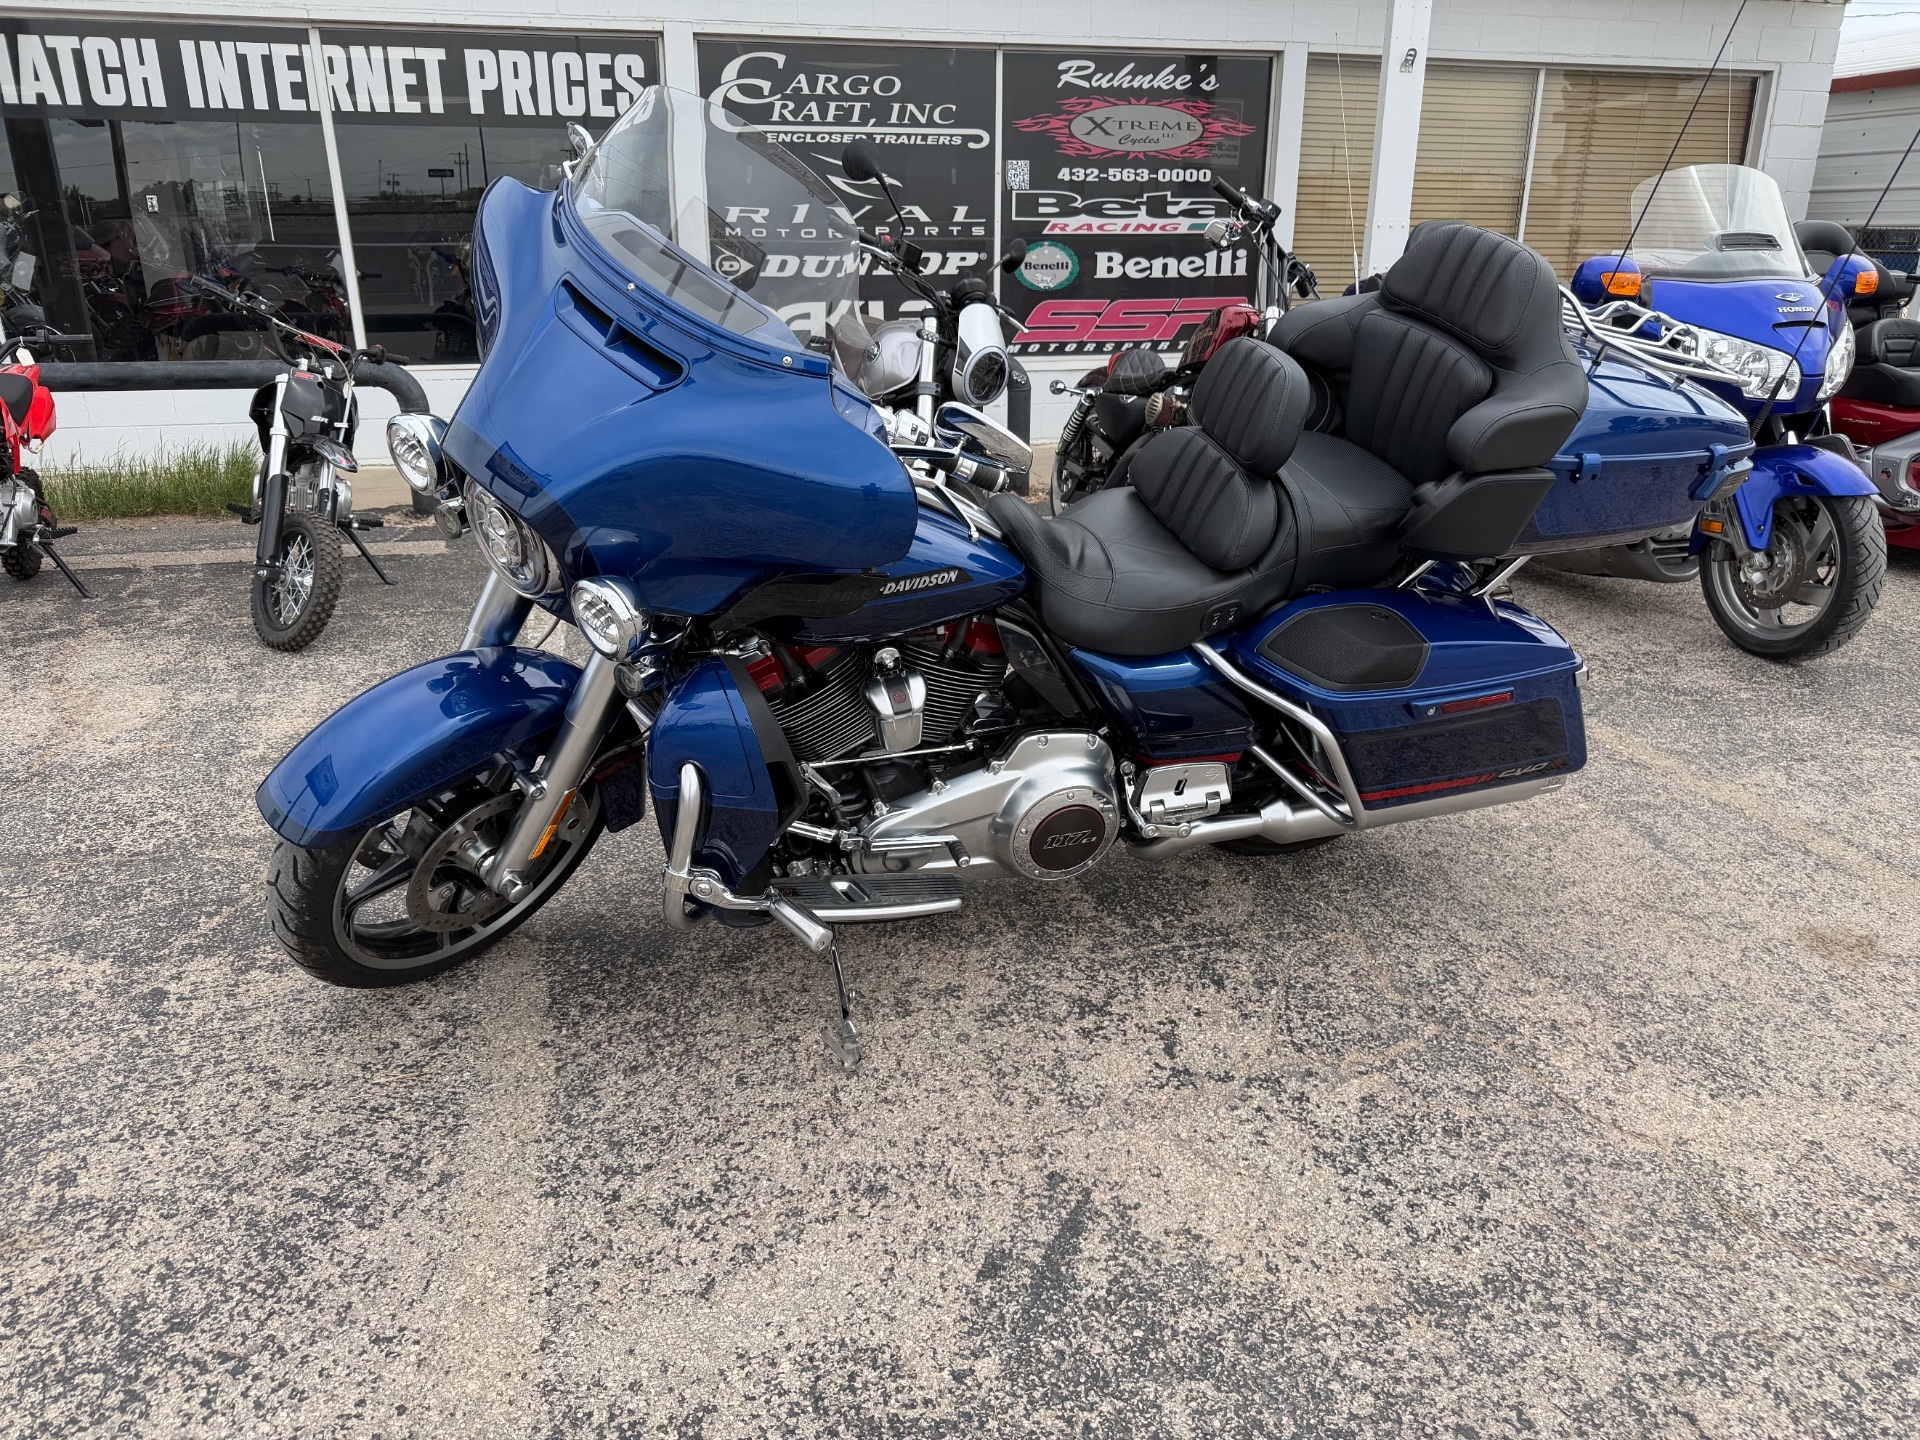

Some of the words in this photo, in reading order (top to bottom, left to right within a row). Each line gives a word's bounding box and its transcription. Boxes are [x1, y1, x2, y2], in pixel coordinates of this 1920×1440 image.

[179, 39, 446, 114] INTERNET
[463, 48, 648, 117] PRICES
[720, 51, 902, 105] CARGO
[1056, 59, 1220, 91] Ruhnke's
[886, 102, 957, 125] INC
[1083, 116, 1197, 136] XTREME
[872, 134, 963, 146] TRAILERS
[1118, 133, 1160, 145] Cycles
[1056, 167, 1212, 183] 432-563-0000
[724, 203, 987, 224] RIVAL
[1012, 190, 1234, 221] Beta
[1047, 222, 1182, 233] RACING
[1024, 261, 1069, 271] Benelli
[1094, 249, 1248, 279] Benelli
[1777, 306, 1818, 314] HONDA
[1497, 761, 1549, 778] CVO
[1043, 829, 1092, 850] 117
